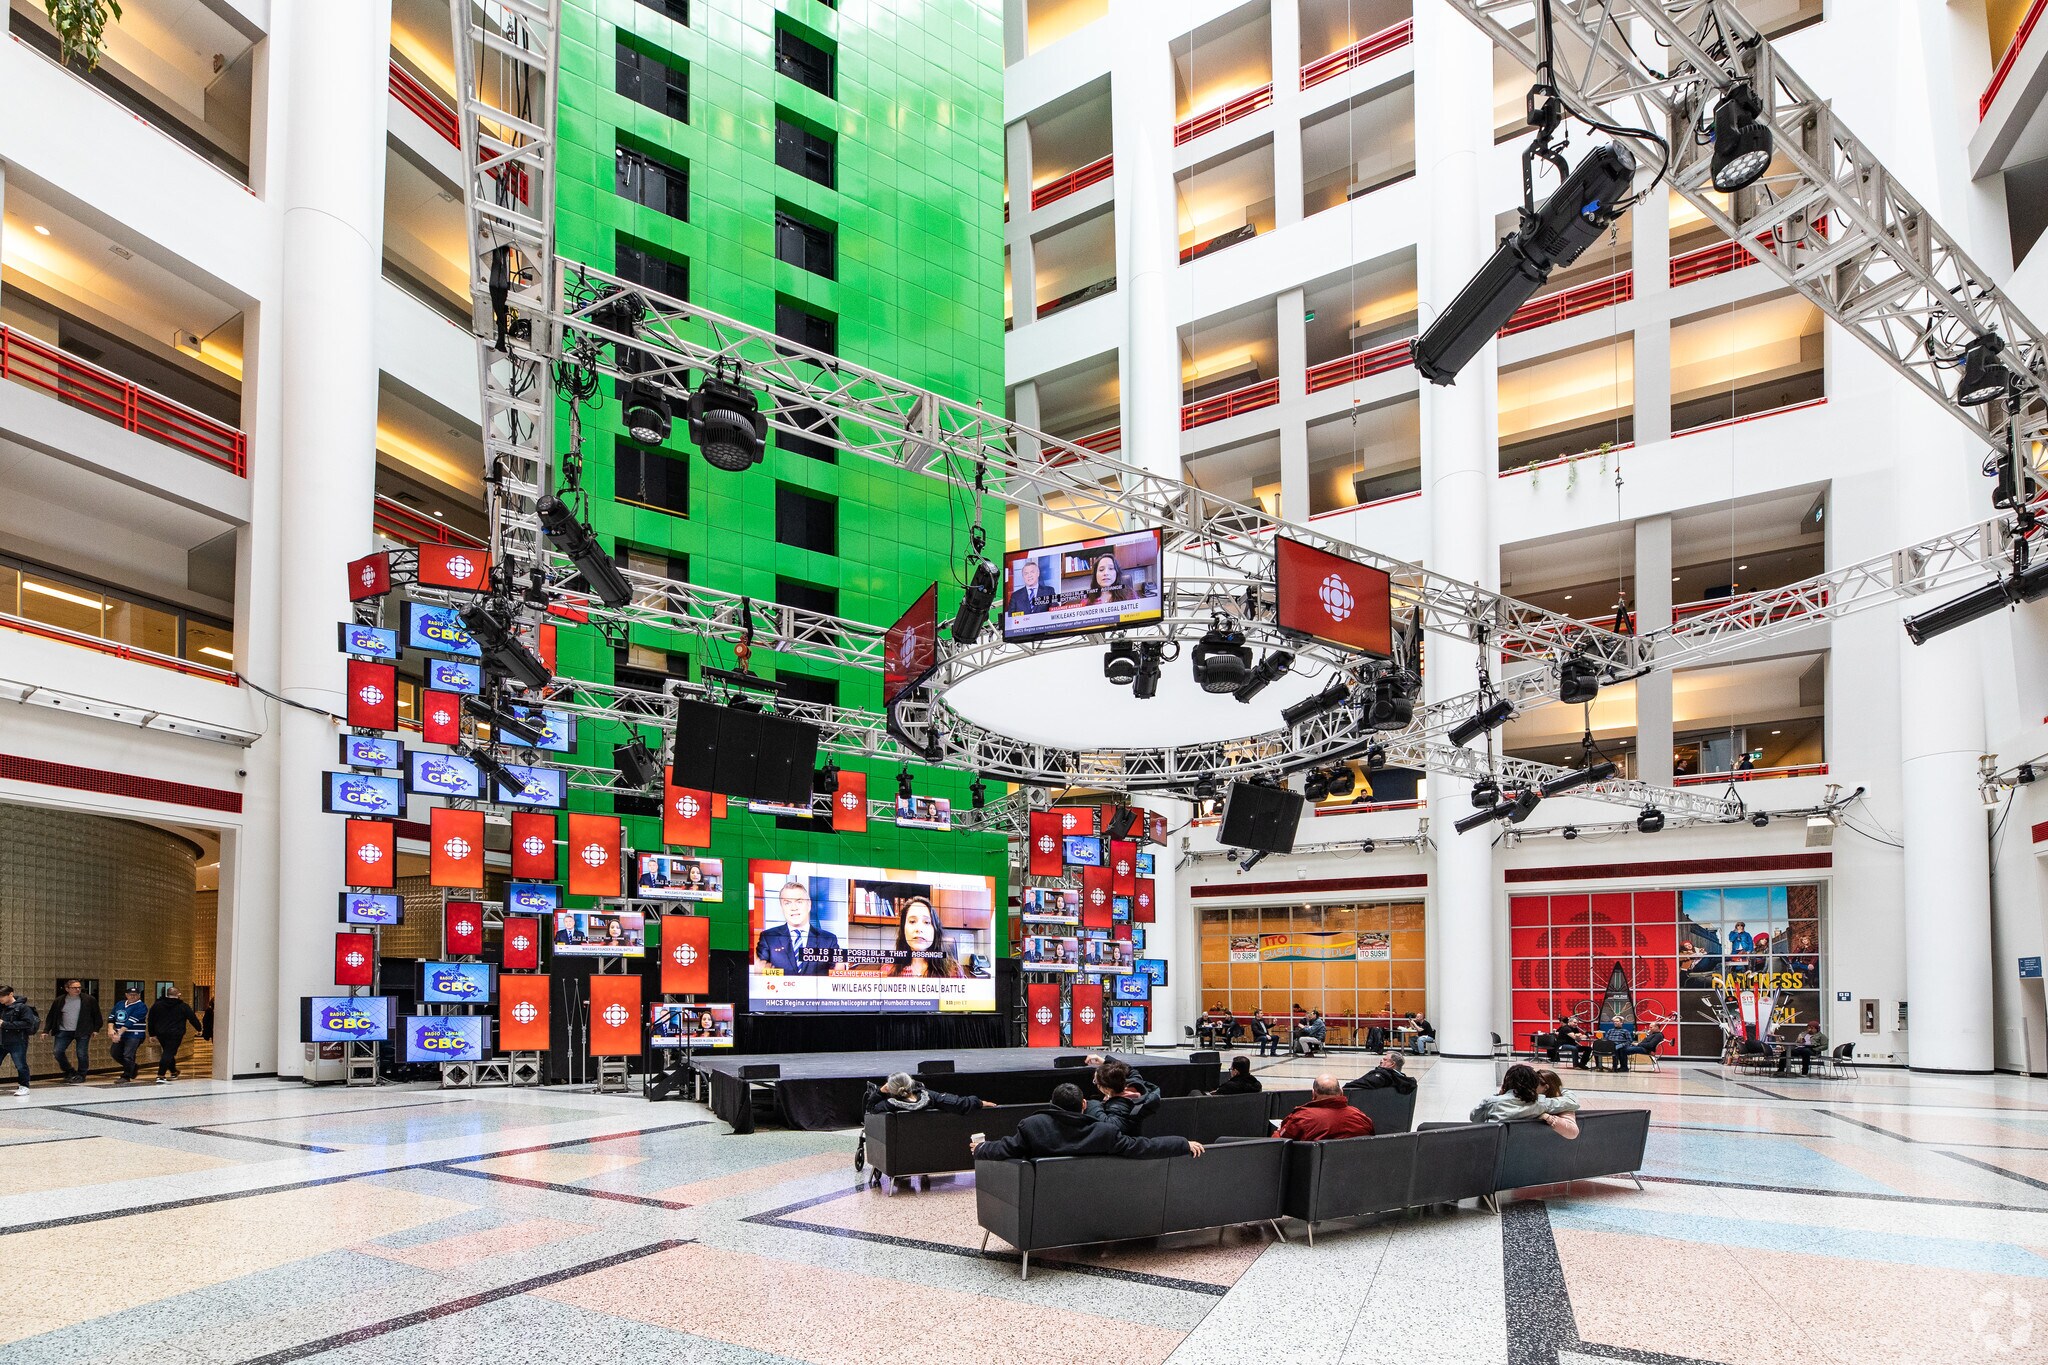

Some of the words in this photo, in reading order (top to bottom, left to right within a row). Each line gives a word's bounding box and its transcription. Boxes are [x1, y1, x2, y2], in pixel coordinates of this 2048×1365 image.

[1121, 603, 1139, 611] BATTLE
[427, 627, 468, 642] CBC
[357, 640, 385, 649] CBC
[442, 675, 469, 684] CBC
[358, 751, 386, 760] CBC
[428, 773, 464, 785] CBC
[347, 792, 383, 804] CBC
[358, 908, 386, 916] CBC
[1265, 935, 1288, 946] ITO
[439, 982, 475, 991] CBC
[832, 983, 872, 993] WIKILEAKS
[874, 984, 906, 993] FOUNDER
[908, 984, 915, 993] IN
[918, 984, 939, 993] LEGAL
[941, 984, 966, 993] BATTLE
[329, 1018, 370, 1029] CBC
[424, 1038, 465, 1049] CBC
